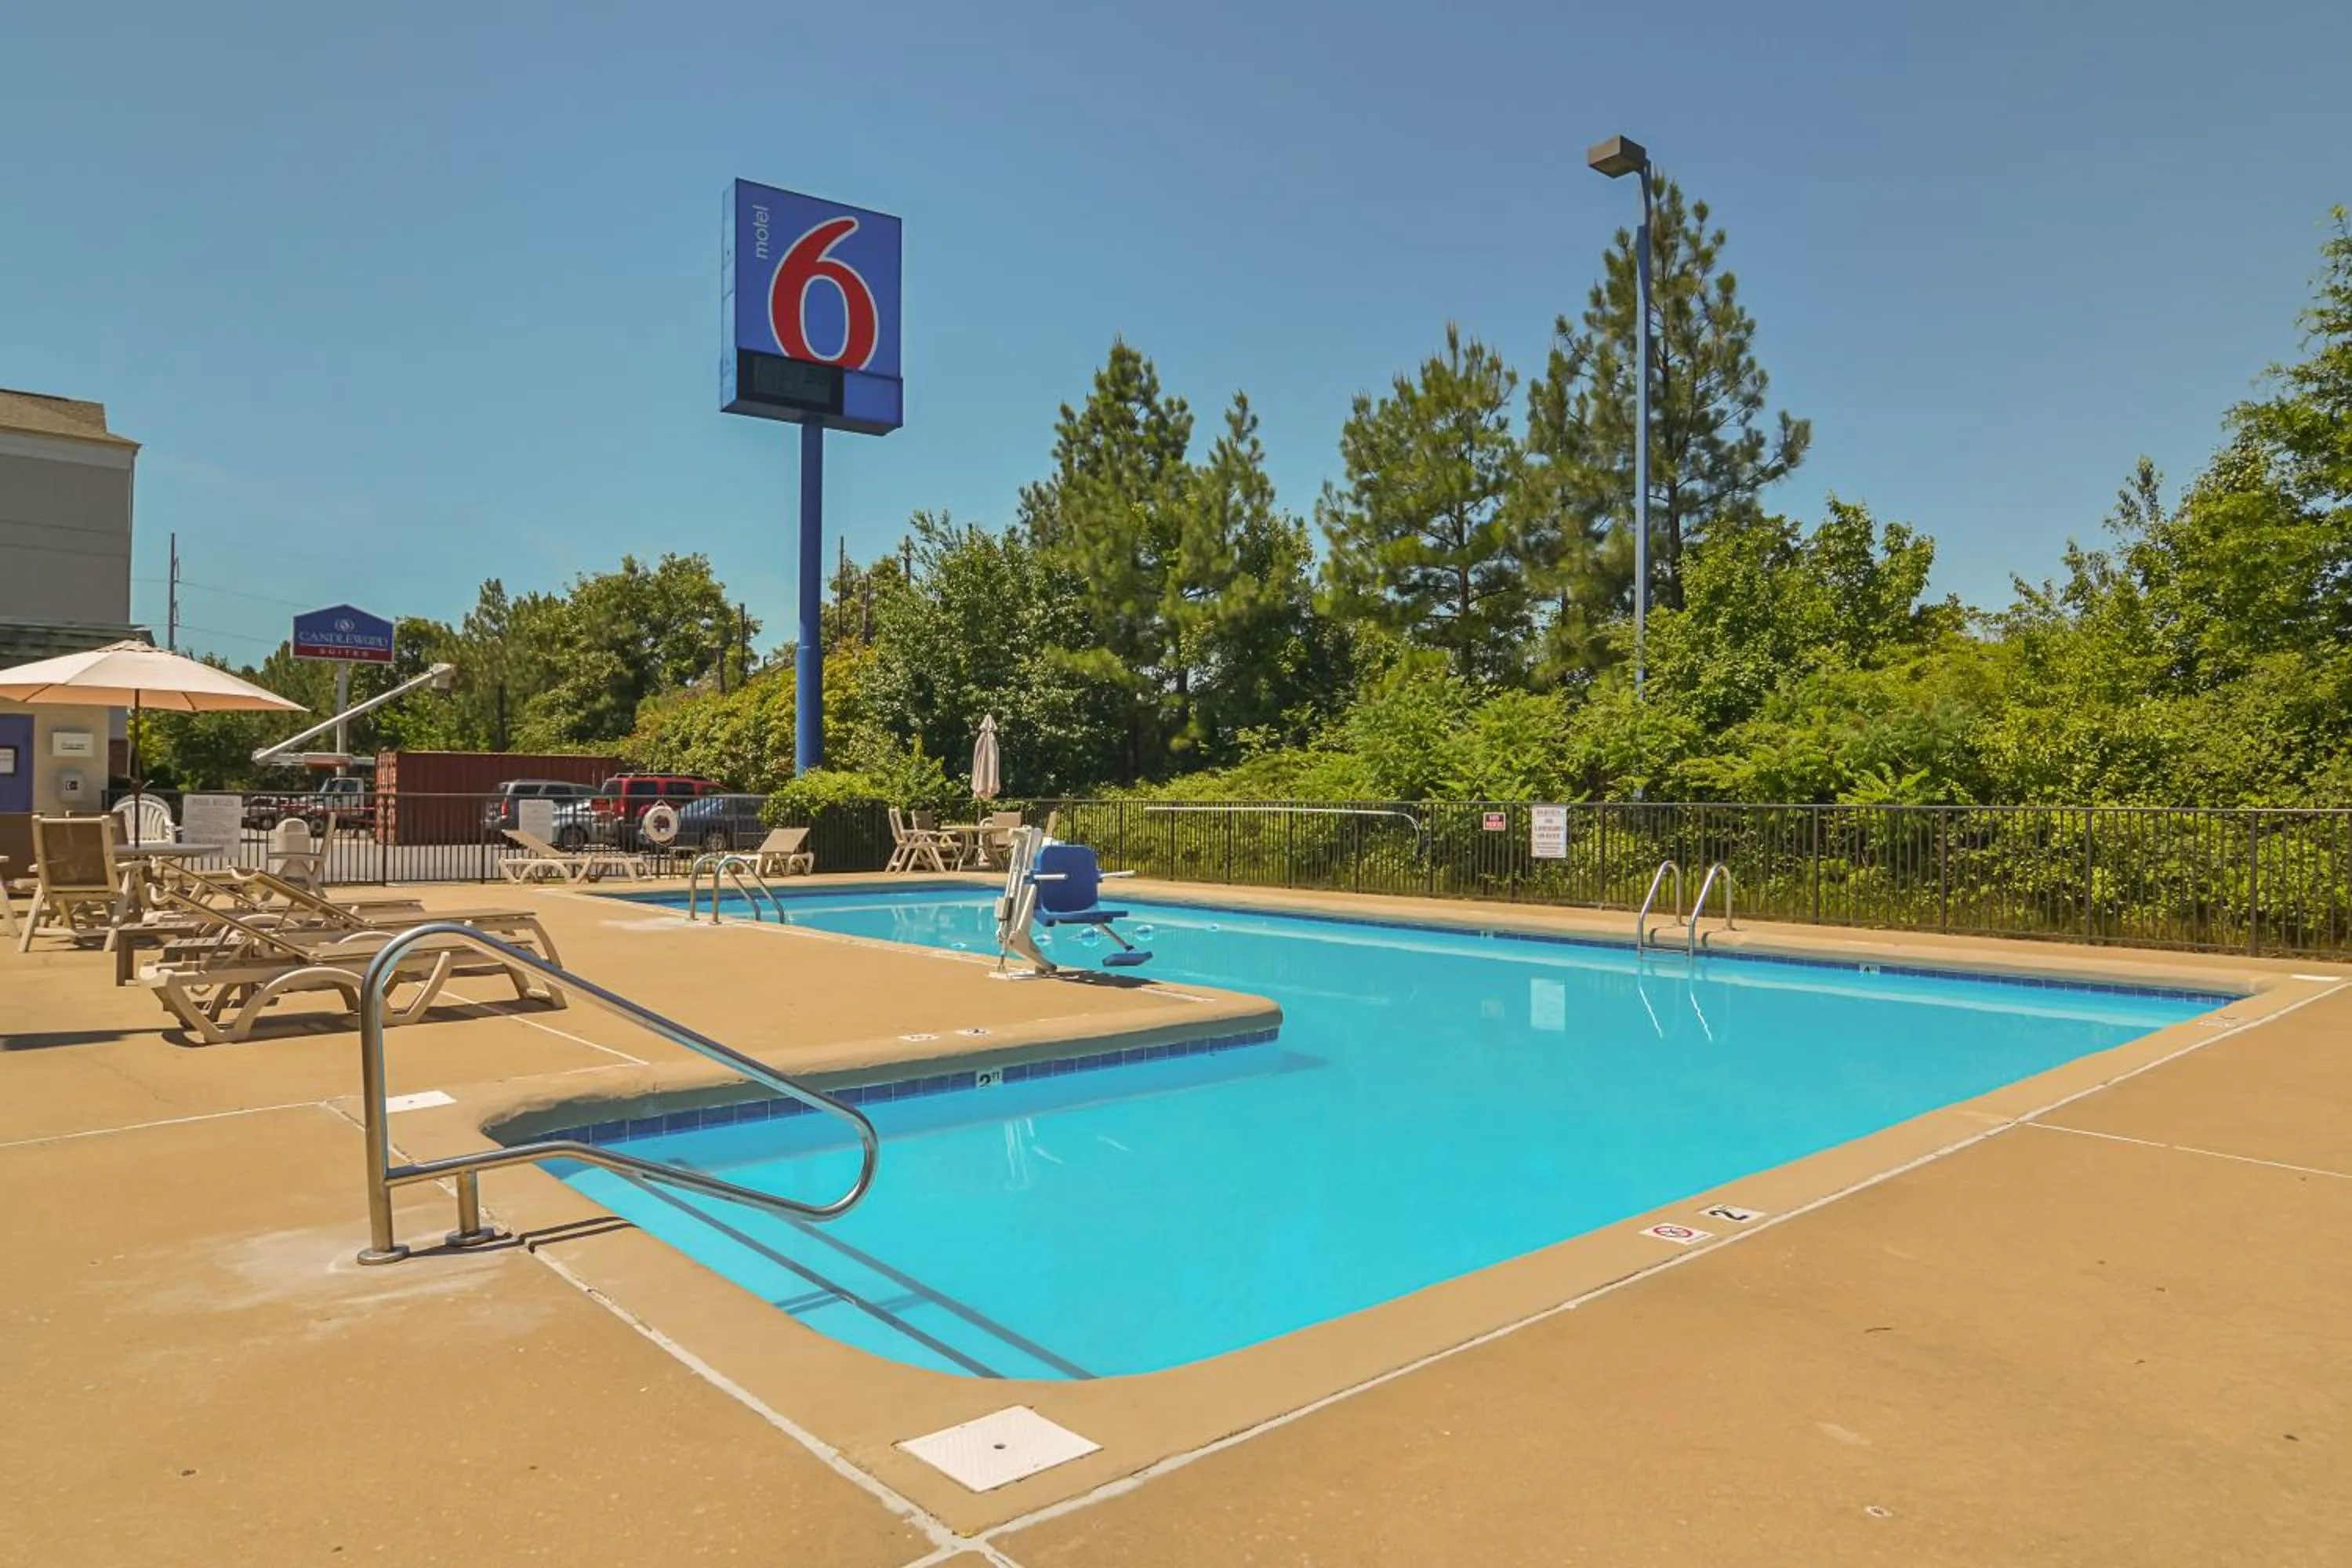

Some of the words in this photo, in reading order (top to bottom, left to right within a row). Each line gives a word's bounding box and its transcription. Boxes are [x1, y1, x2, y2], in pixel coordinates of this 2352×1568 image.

[753, 204, 769, 260] motel
[769, 216, 879, 370] 6
[979, 1073, 991, 1087] 2
